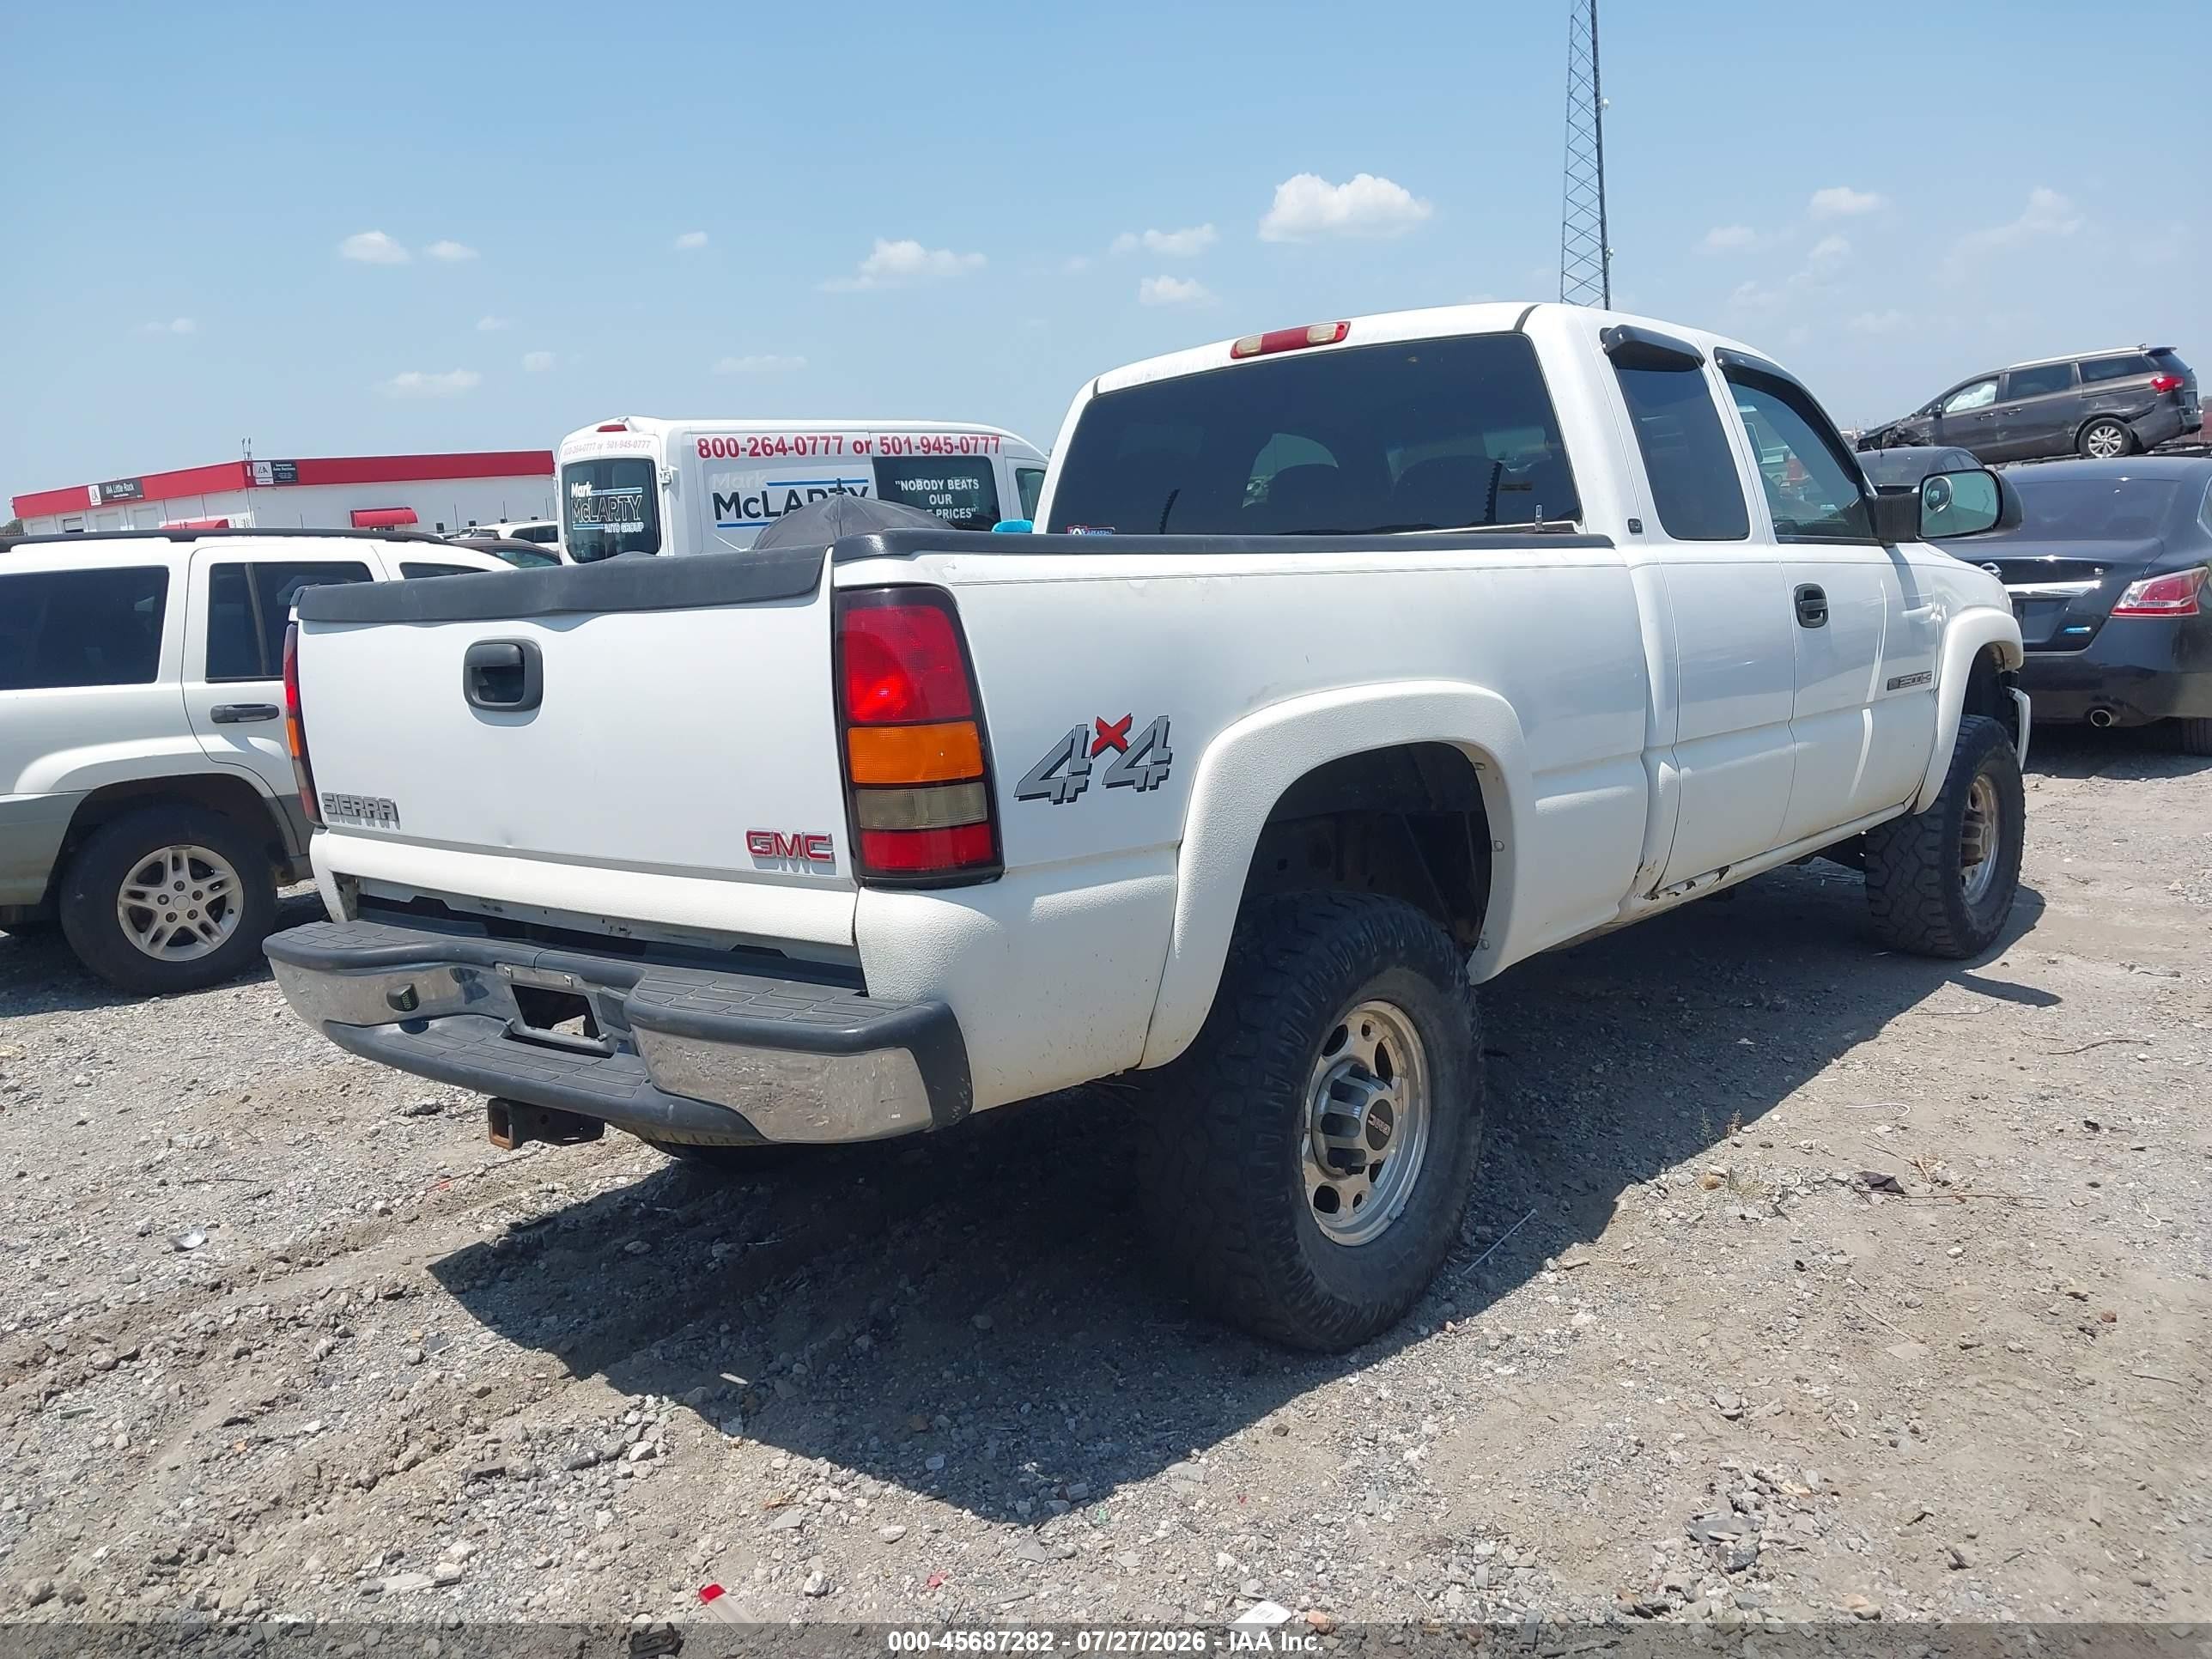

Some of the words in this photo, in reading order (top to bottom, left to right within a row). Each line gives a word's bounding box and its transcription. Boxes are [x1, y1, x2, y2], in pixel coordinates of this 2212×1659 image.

[696, 435, 844, 459] 800-264-0777
[852, 439, 872, 454] or
[879, 435, 1000, 455] 501-945-0777
[571, 481, 592, 498] Mark
[895, 479, 945, 491] "NOBODY
[947, 478, 979, 490] BEATS
[571, 495, 642, 523] McLARTY
[713, 486, 869, 520] McLA
[928, 494, 952, 505] OUR
[936, 507, 976, 519] PRICES"
[604, 523, 620, 532] AUTO
[620, 522, 644, 532] GROUP
[321, 793, 398, 823] SIERRA
[745, 829, 836, 863] GMC
